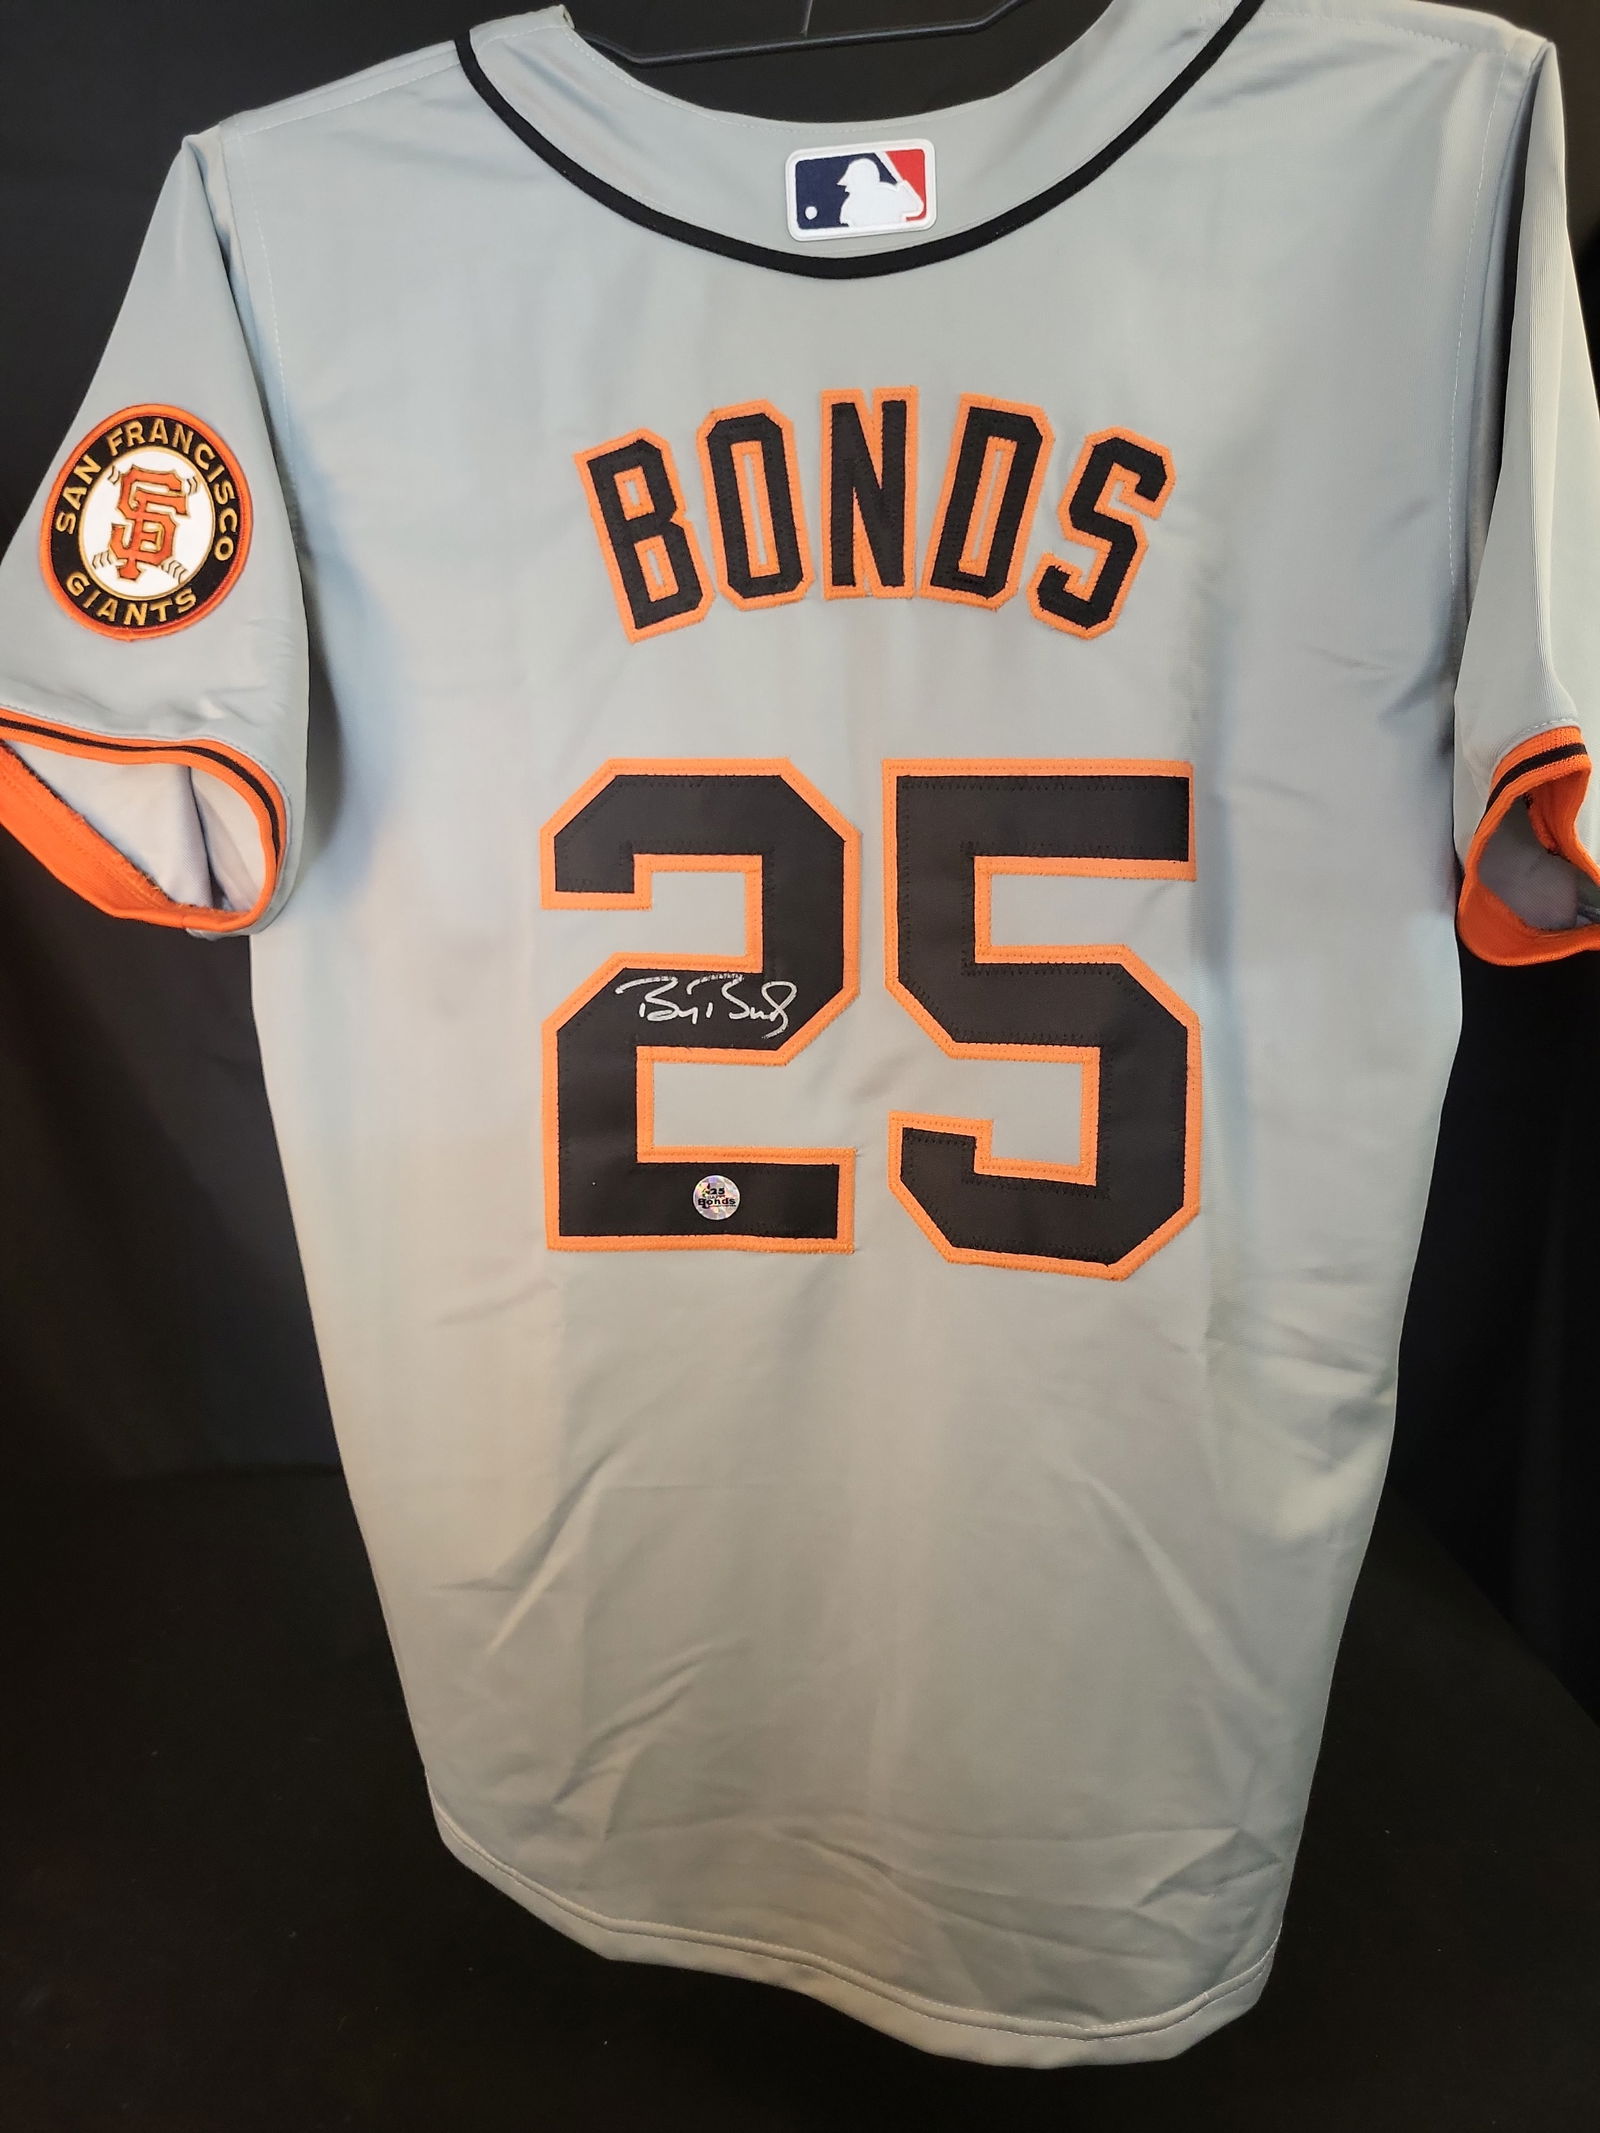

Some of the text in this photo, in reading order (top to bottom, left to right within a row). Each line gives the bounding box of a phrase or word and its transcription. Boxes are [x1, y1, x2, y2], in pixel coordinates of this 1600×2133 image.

[55, 418, 238, 562] SAN FRANCISCO
[574, 386, 1176, 642] BONDS
[66, 571, 197, 626] GIANTS
[540, 758, 1202, 1281] 25
